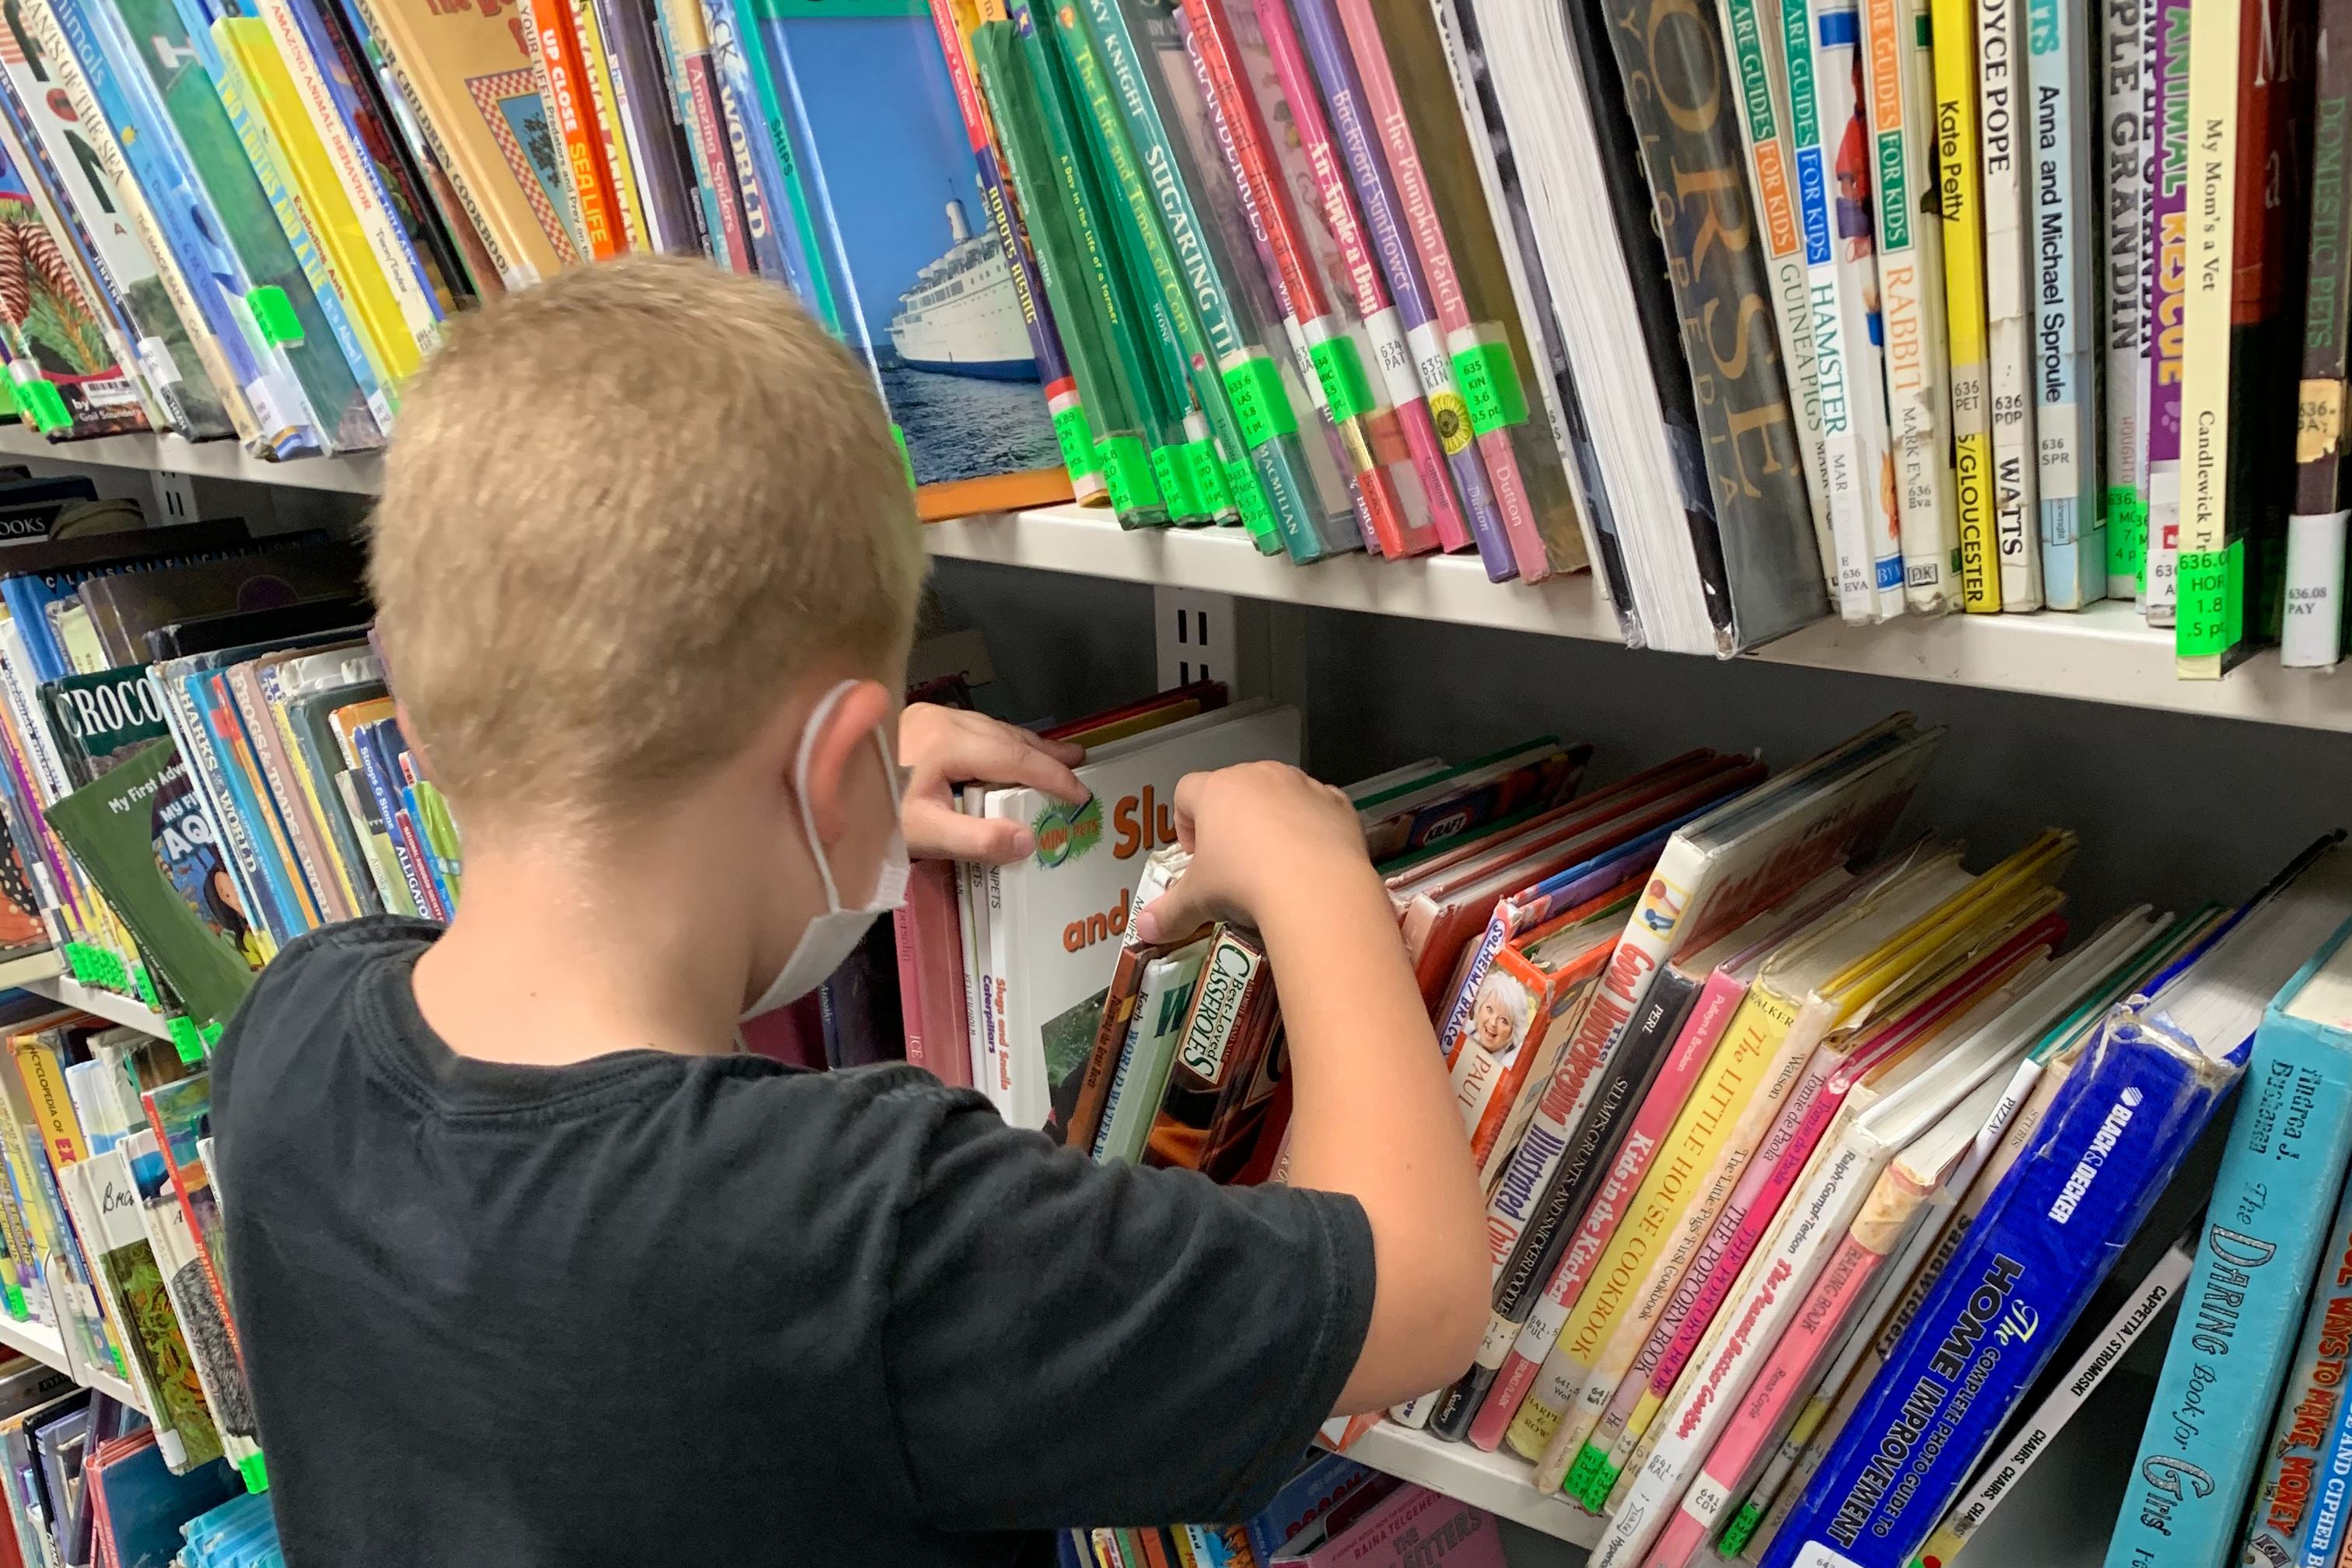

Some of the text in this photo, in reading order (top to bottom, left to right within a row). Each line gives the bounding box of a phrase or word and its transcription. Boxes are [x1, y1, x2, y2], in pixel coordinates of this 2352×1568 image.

[521, 6, 540, 54] YOUR
[271, 5, 372, 212] AMAZING ANIMAL BEHAVIOR
[1104, 33, 1145, 117] KNIGHT
[100, 138, 125, 186] SEA
[397, 69, 453, 170] CHILDREN
[542, 29, 609, 245] UP CLOSE SEA LIFE
[689, 68, 734, 233] Amazing Spiders
[720, 85, 766, 240] WORLD
[770, 118, 793, 177] SHIPS
[1741, 54, 1794, 250] GUIDES FOR KIDS
[1791, 58, 1830, 263] GUIDES FOR KIDS
[1874, 39, 1906, 243] GUIDES FOR KIDS
[1939, 100, 1963, 222] Kate Petty
[1986, 86, 2011, 176] POPE
[216, 71, 328, 294] TWO TRUTHS AND LIE
[352, 135, 418, 267] WINTER LULLABY
[547, 107, 585, 226] Predators and Prey
[1076, 44, 1189, 334] The Life Times Corn
[1384, 103, 1462, 314] The Pumpkin Patch
[2202, 118, 2224, 292] My Mom's Vet
[2312, 94, 2347, 262] DOMESTIC
[293, 194, 328, 265] Exploding
[988, 185, 1017, 259] ROBOTS
[1144, 143, 1220, 311] SUGARING
[2038, 85, 2067, 404] Anna and Michael Sproule
[2110, 110, 2139, 349] GRANDIN
[92, 250, 122, 306] JENKINS
[1779, 261, 1814, 374] GUINEA
[1379, 339, 1402, 358] 634
[1384, 352, 1407, 372] PAT
[1462, 359, 1483, 376] 635
[1811, 281, 1849, 437] HAMSTER
[1886, 264, 1923, 392] RABBIT
[71, 397, 91, 409] by
[169, 402, 187, 430] HMH
[1425, 369, 1449, 390] KIN
[1468, 376, 1486, 391] KIN
[1472, 390, 1490, 405] 3.6
[1955, 380, 1979, 397] 636
[1955, 397, 1979, 411] PET
[1995, 394, 2023, 411] 636
[1995, 411, 2024, 425] POP
[1902, 405, 1921, 457] MARK
[2042, 438, 2065, 451] 636
[2042, 452, 2070, 466] SPR
[2196, 410, 2216, 524] Candlewick
[1258, 444, 1300, 537] MACMILLAN
[1496, 465, 1523, 528] Dutton
[1998, 457, 2024, 556] WATTS
[2186, 621, 2203, 638] .5
[2197, 597, 2222, 614] 1.8
[2288, 586, 2328, 600] 636.08
[2288, 603, 2317, 615] PAY
[107, 775, 159, 814] My First
[173, 677, 219, 772] SHARKS
[220, 789, 258, 873] WORLD
[235, 670, 269, 749] FROGS
[269, 767, 301, 839] TOADS
[359, 745, 394, 831] Stoops & Stone
[1425, 815, 1467, 843] KRAFT
[370, 856, 390, 892] Arnosky
[403, 825, 444, 922] NATIONAL AUDUBON SOCIETY
[1062, 887, 1131, 954] and
[982, 974, 996, 1055] Caterpillars
[1183, 943, 1251, 1080] CASSEROLES
[1603, 942, 1656, 1004] Good
[995, 977, 1012, 1092] Slugs and Snails
[1113, 989, 1150, 1087] Koch WORLD
[1641, 1003, 1664, 1035] PERL
[1762, 1071, 1827, 1163] Tomie Paola
[1768, 1052, 1806, 1101] Watson
[2287, 1066, 2323, 1140] Andrea
[51, 1118, 65, 1133] OF
[1548, 1129, 1656, 1305] Kids Kitchen
[1570, 1024, 1767, 1361] The LITTLE HOUSE COOKBOOK
[1637, 1147, 1749, 1322] The Cookbook
[194, 1241, 241, 1354] PRAIRIE DOG SONG
[1633, 1203, 1748, 1379] THE POPCORN BOOK
[1826, 1245, 1862, 1299] BAKING
[1526, 1323, 1542, 1340] PUL
[2070, 1284, 2168, 1398] CAPPETTA STROMOSKI
[2172, 1181, 2277, 1451] The DARING Book for
[1825, 1251, 2040, 1550] The HOME IMPROVEMENT
[1871, 1346, 2002, 1540] COMPLETE PHOTO GUIDE TO
[1647, 1460, 1666, 1482] RAL
[1694, 1495, 1717, 1515] COY
[1699, 1487, 1720, 1507] 641
[2266, 1387, 2340, 1538] MAKE MONEY
[2312, 1478, 2346, 1552] CIPHER
